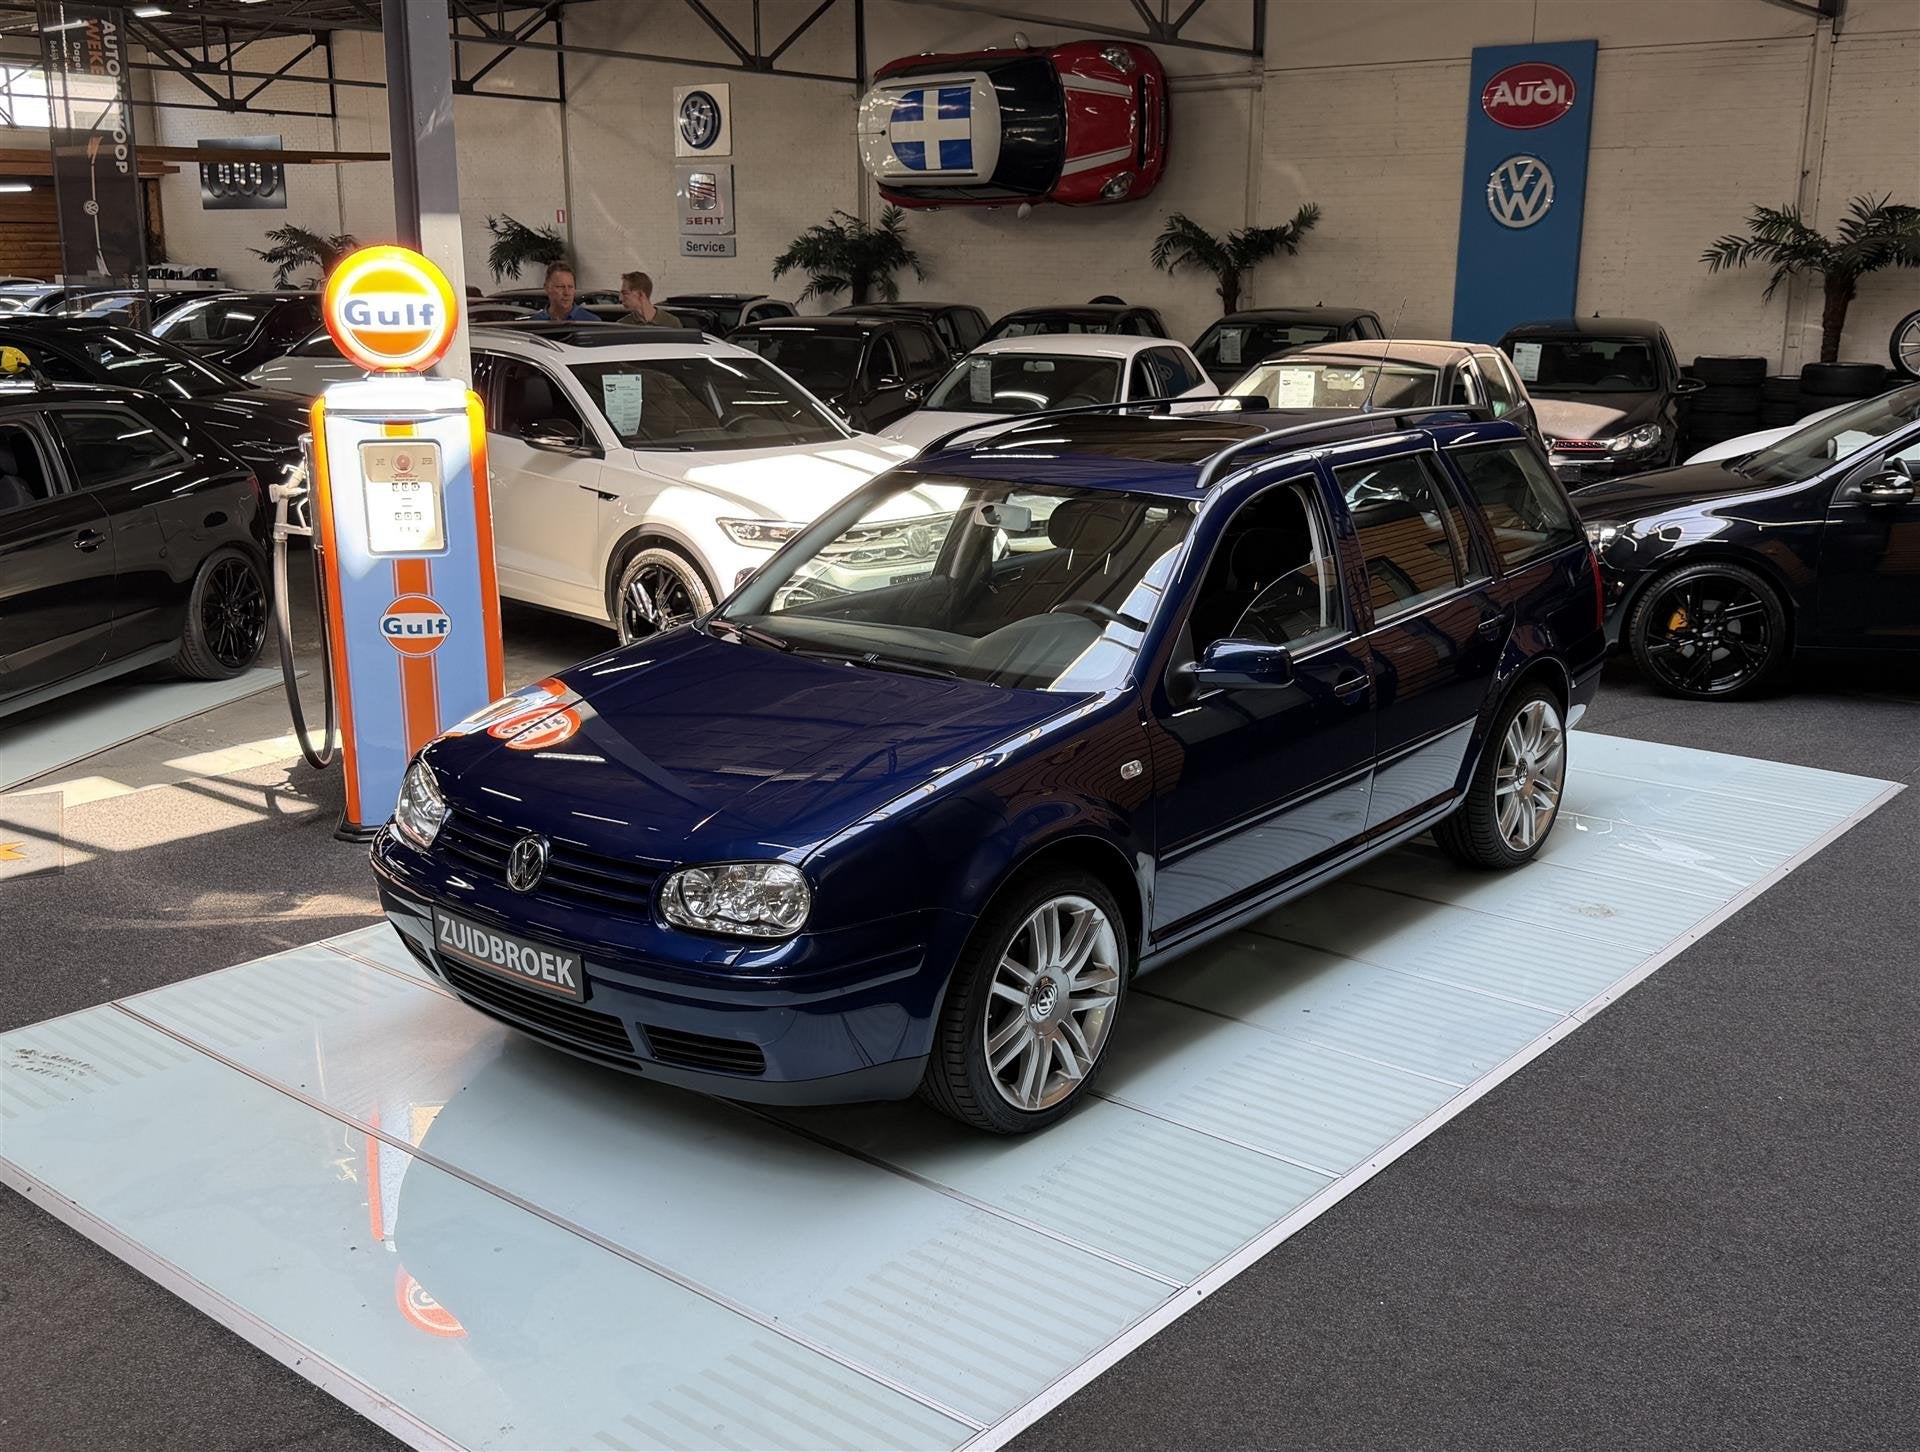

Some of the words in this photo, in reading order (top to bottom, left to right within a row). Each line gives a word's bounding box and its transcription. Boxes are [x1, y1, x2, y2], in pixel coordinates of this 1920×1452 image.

[1491, 79, 1566, 107] Audi
[1489, 155, 1553, 228] VW
[686, 216, 724, 225] SEAT
[686, 240, 726, 252] Service
[344, 299, 435, 326] Gulf
[383, 616, 448, 635] Gulf
[438, 914, 576, 988] ZUIDBROEK
